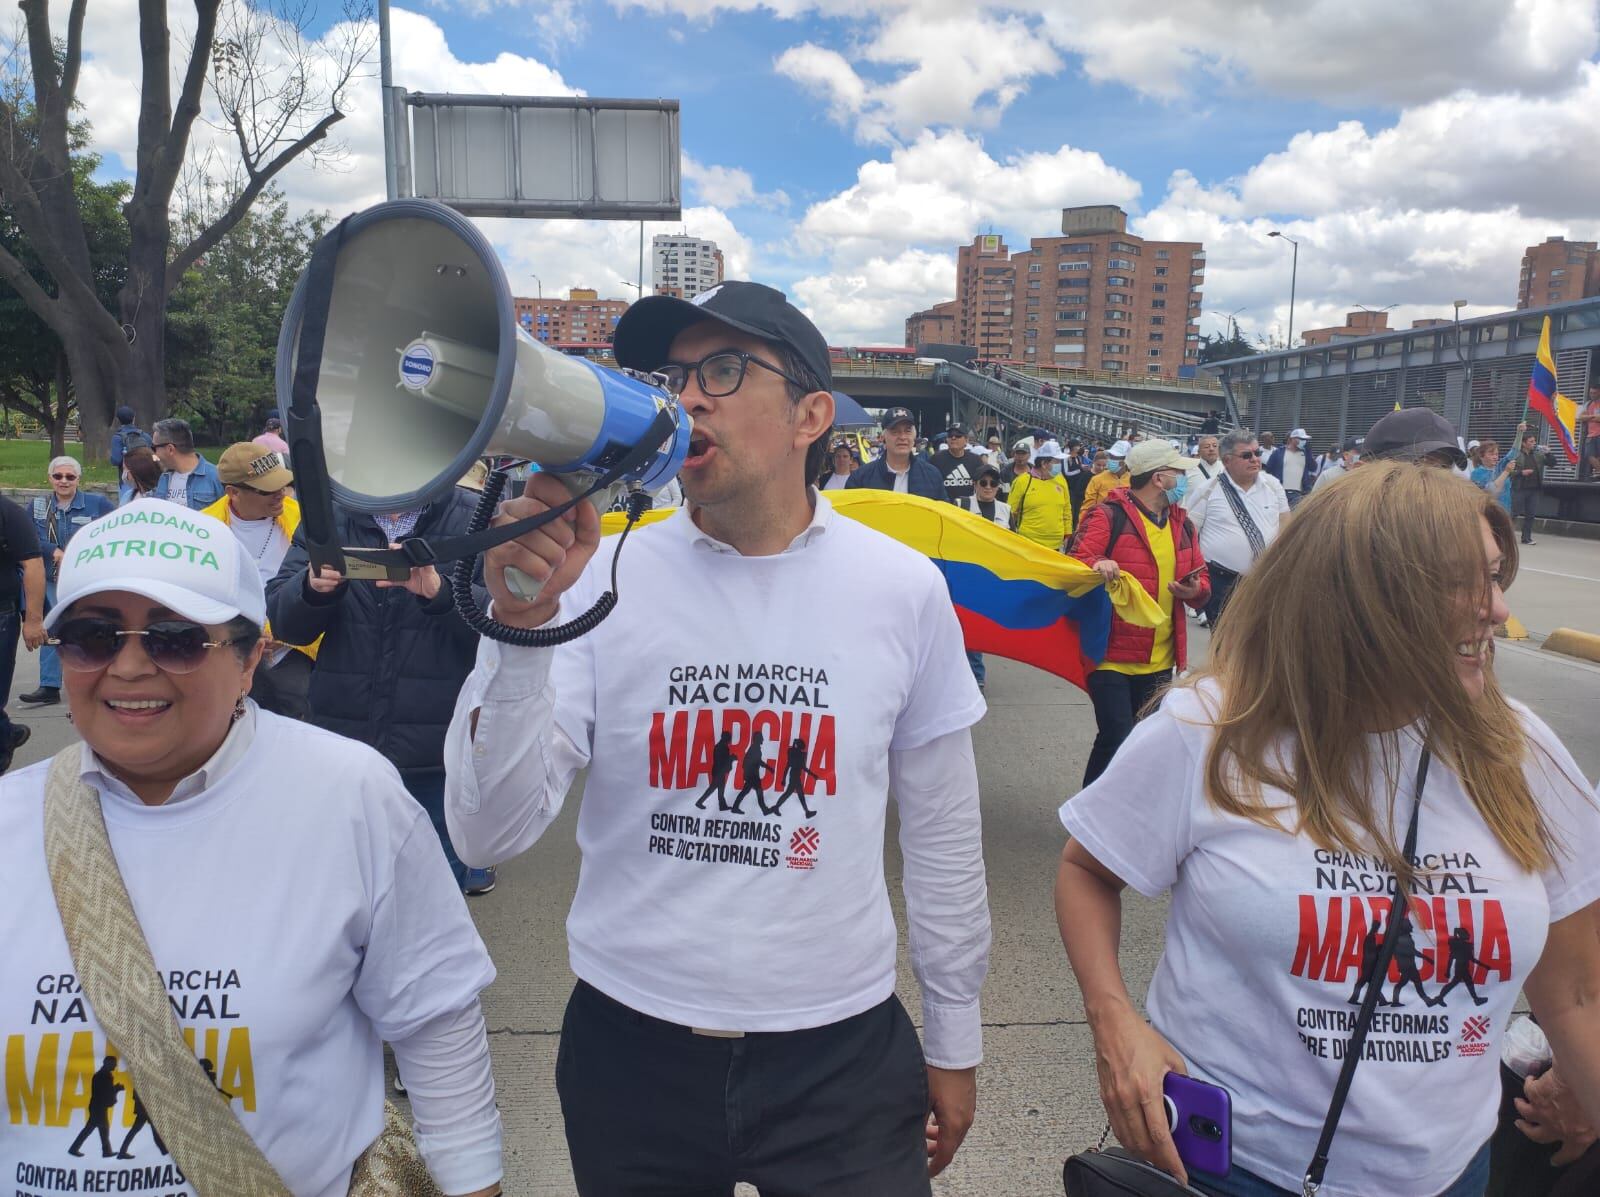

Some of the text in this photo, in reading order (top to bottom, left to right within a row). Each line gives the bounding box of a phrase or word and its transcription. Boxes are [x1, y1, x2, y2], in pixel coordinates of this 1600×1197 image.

[943, 478, 973, 487] adidas
[89, 511, 210, 540] CIUDADANO
[74, 539, 220, 571] PATRIOTA
[669, 663, 829, 686] GRAN MARCHA
[668, 682, 829, 709] NACIONAL
[648, 708, 837, 796] MARCHA
[651, 813, 782, 843] CONTRA REFORMAS
[648, 835, 781, 868] PRE DICTATORIALES
[1314, 848, 1481, 873] GRAN MRCHA
[1296, 1007, 1449, 1034] CONTRA EFORMAS
[16, 1161, 187, 1193] CONTRA REFORMAS
